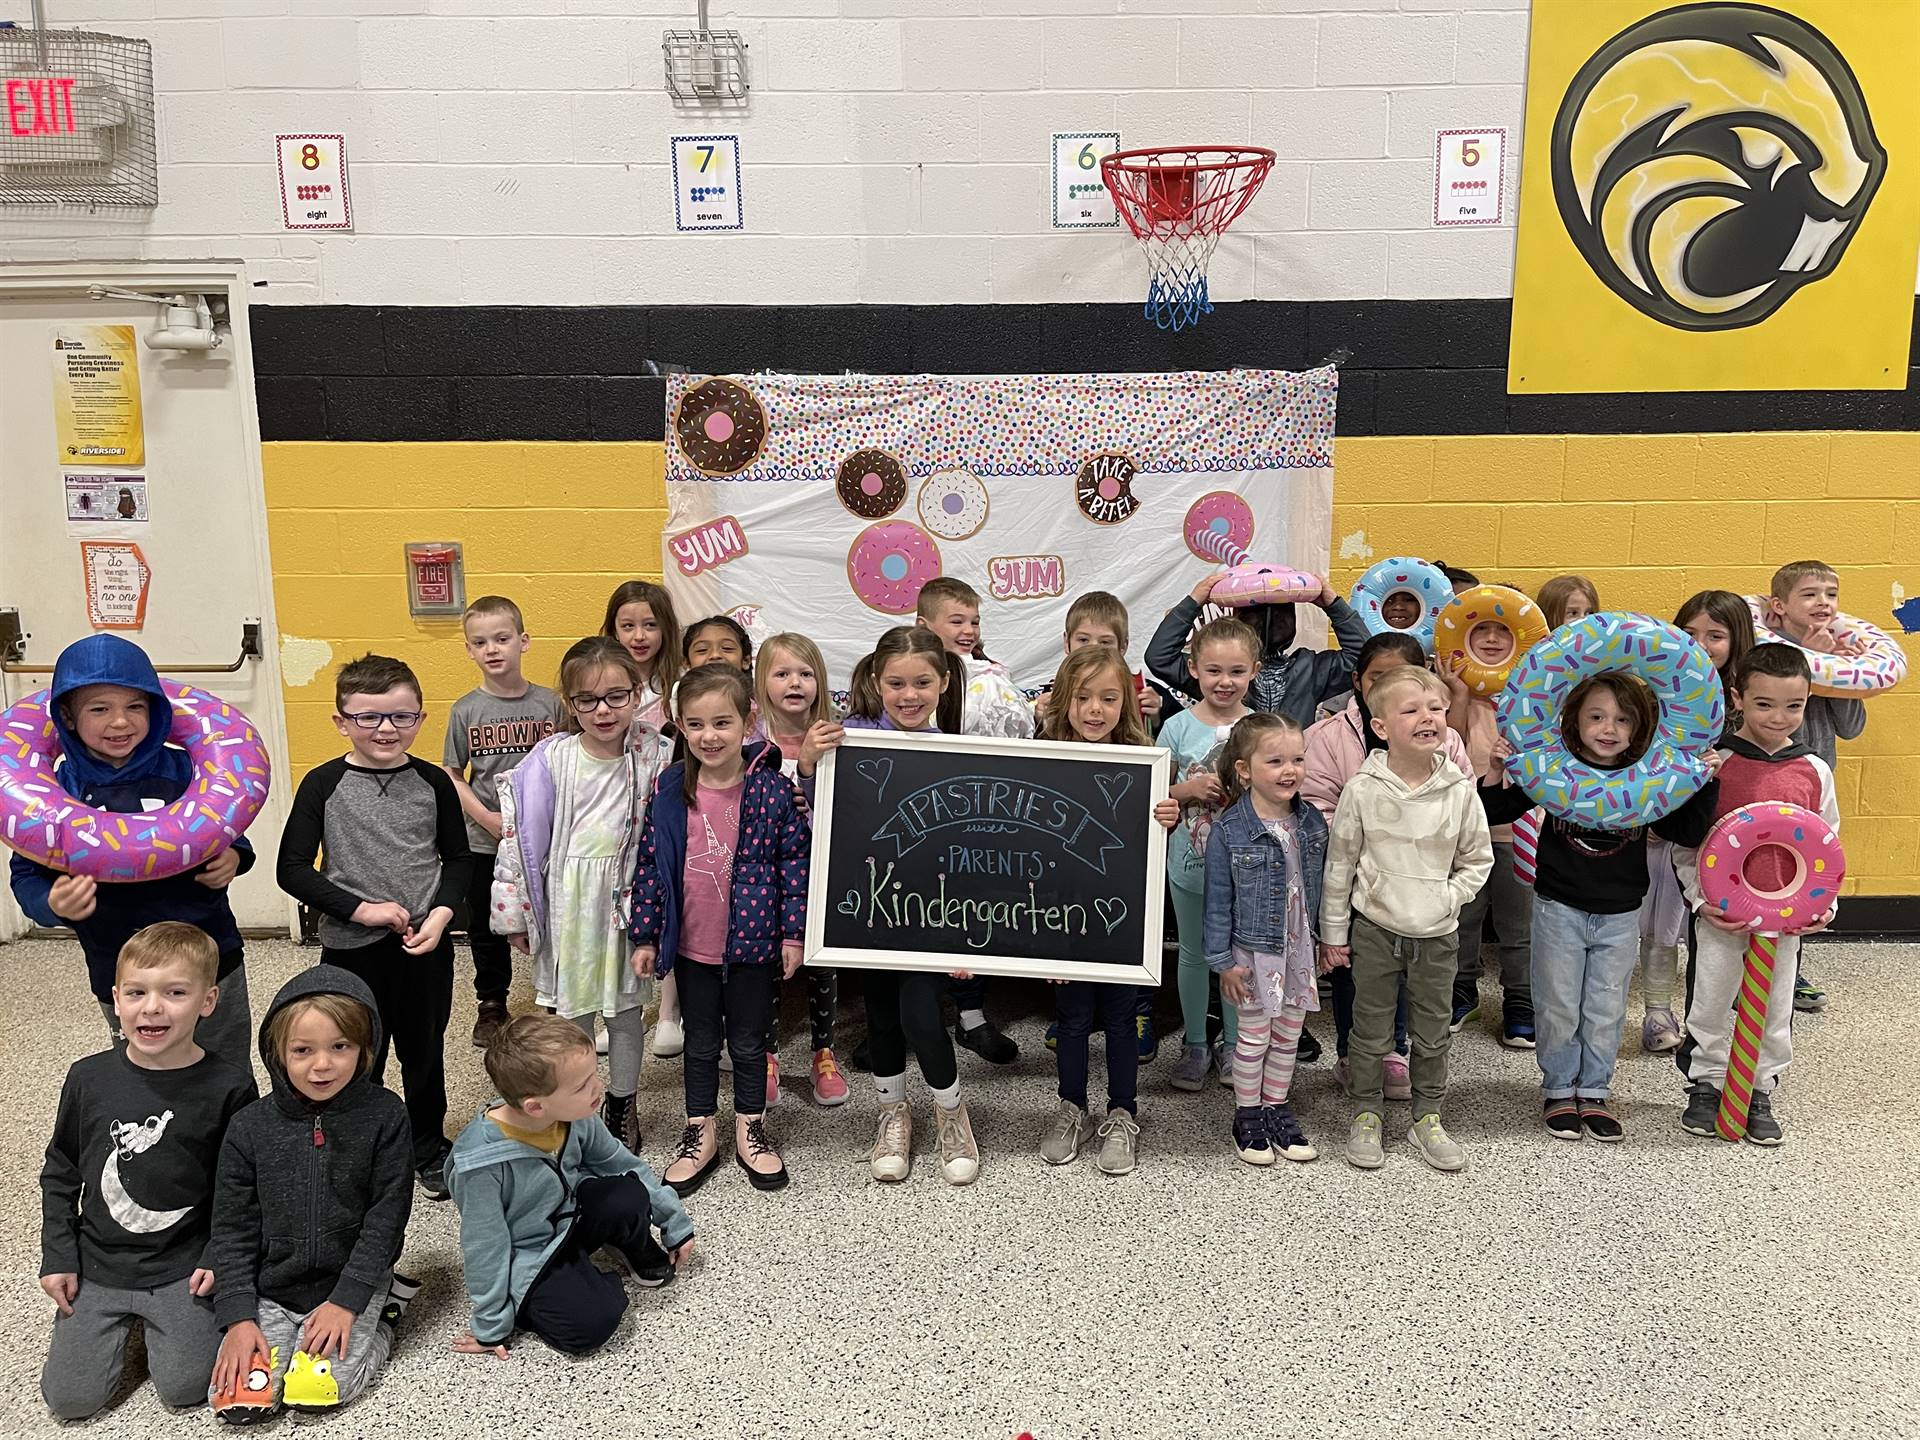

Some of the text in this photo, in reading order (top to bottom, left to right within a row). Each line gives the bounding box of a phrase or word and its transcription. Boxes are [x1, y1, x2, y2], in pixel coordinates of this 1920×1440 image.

[6, 79, 76, 137] EXIT
[302, 144, 320, 170] 8
[696, 145, 715, 173] 7
[1078, 143, 1096, 170] 6
[1462, 139, 1480, 167] 5
[306, 210, 328, 220] eight
[696, 213, 723, 221] seven
[1080, 209, 1092, 218] six
[1459, 206, 1477, 215] five
[80, 447, 126, 456] RIVERSIDE!
[1091, 456, 1131, 483] TAKE
[1079, 487, 1095, 500] A
[1089, 495, 1131, 521] BITE!
[675, 520, 743, 572] YUM
[107, 554, 123, 567] do
[418, 566, 445, 582] FIRE
[993, 560, 1060, 596] YUM
[101, 592, 139, 602] no one
[490, 715, 535, 724] CLEVELAND
[468, 721, 555, 749] BROWNS
[475, 746, 528, 757] FOOTBALL
[908, 782, 1071, 828] PASTRIES
[962, 820, 1020, 834] with
[948, 844, 1044, 881] PARENTS
[865, 856, 1088, 948] Kindergarten
